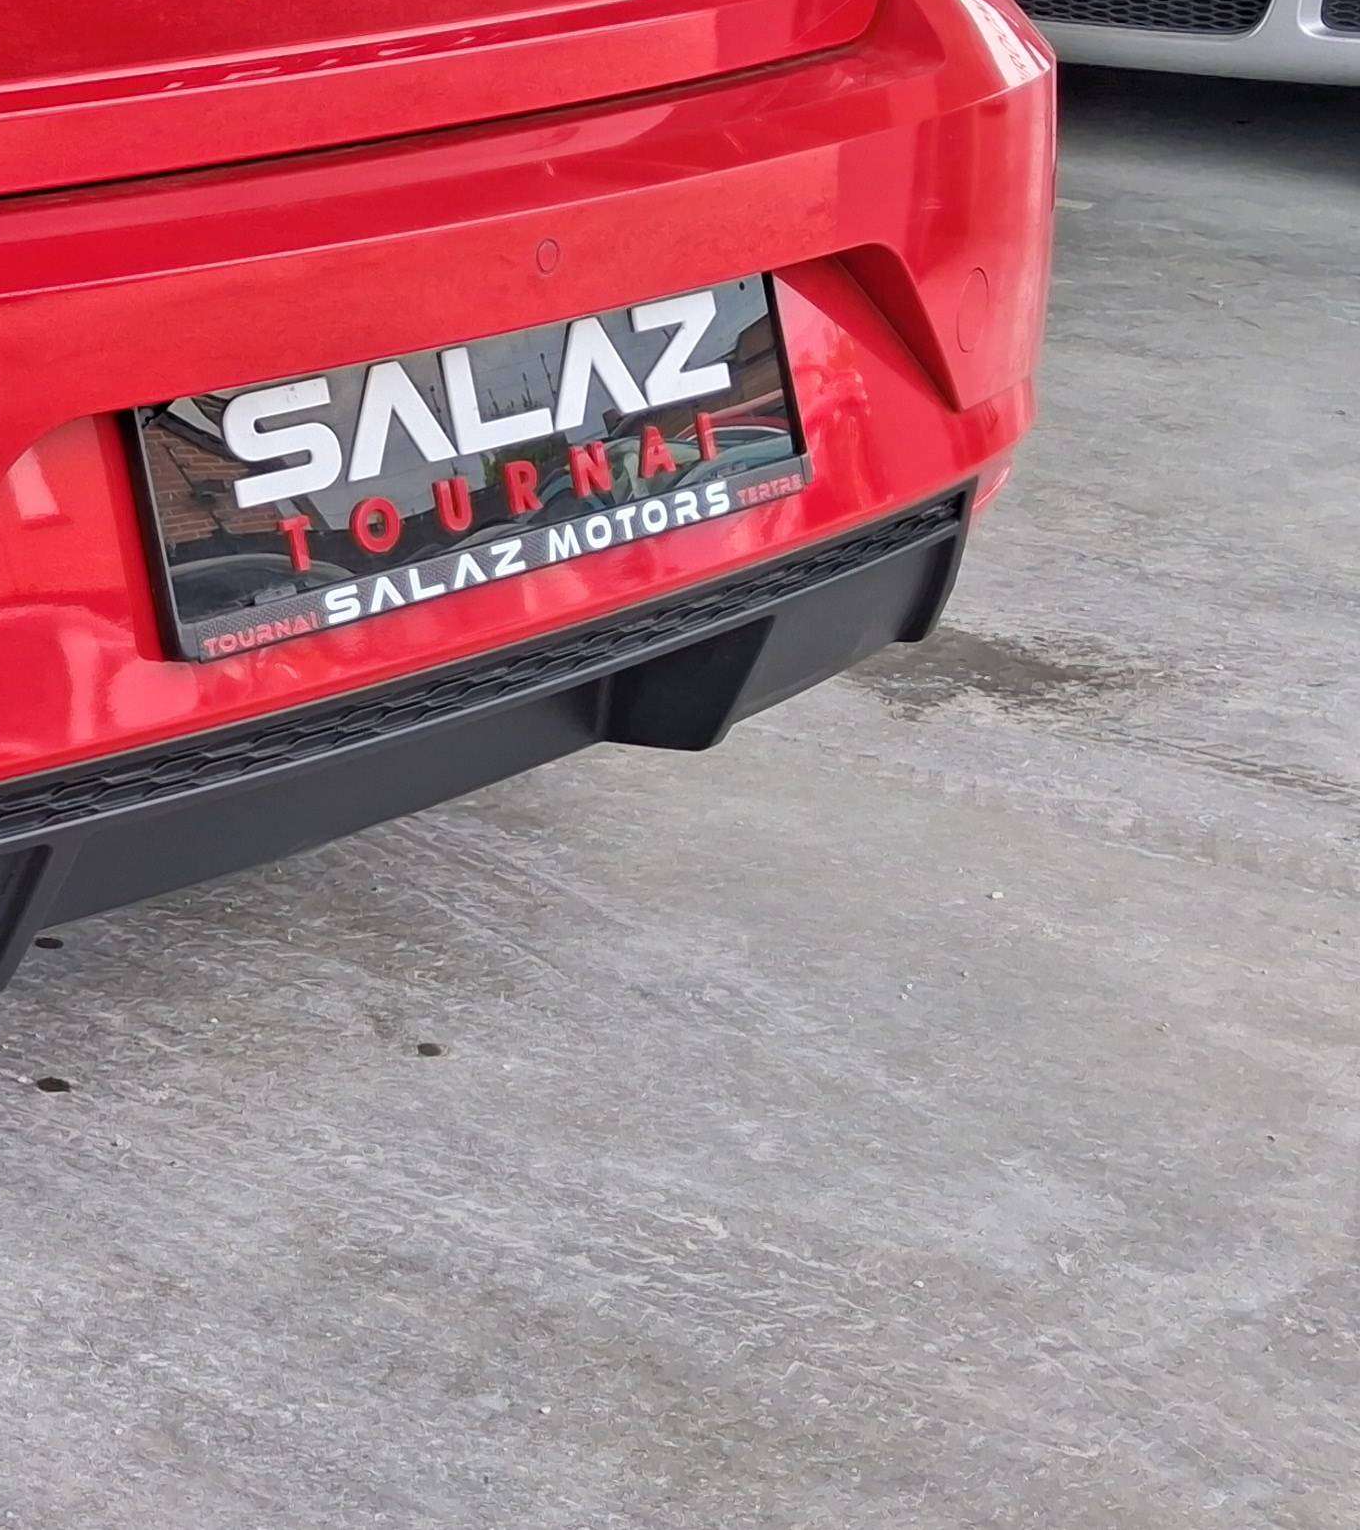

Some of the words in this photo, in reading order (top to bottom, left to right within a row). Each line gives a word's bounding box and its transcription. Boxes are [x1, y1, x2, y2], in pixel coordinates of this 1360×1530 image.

[221, 290, 732, 509] SALAZ
[201, 610, 321, 657] TOURNAI
[323, 540, 526, 625] SALAZ
[546, 480, 731, 564] MOTORS
[278, 411, 719, 572] TOURNAI
